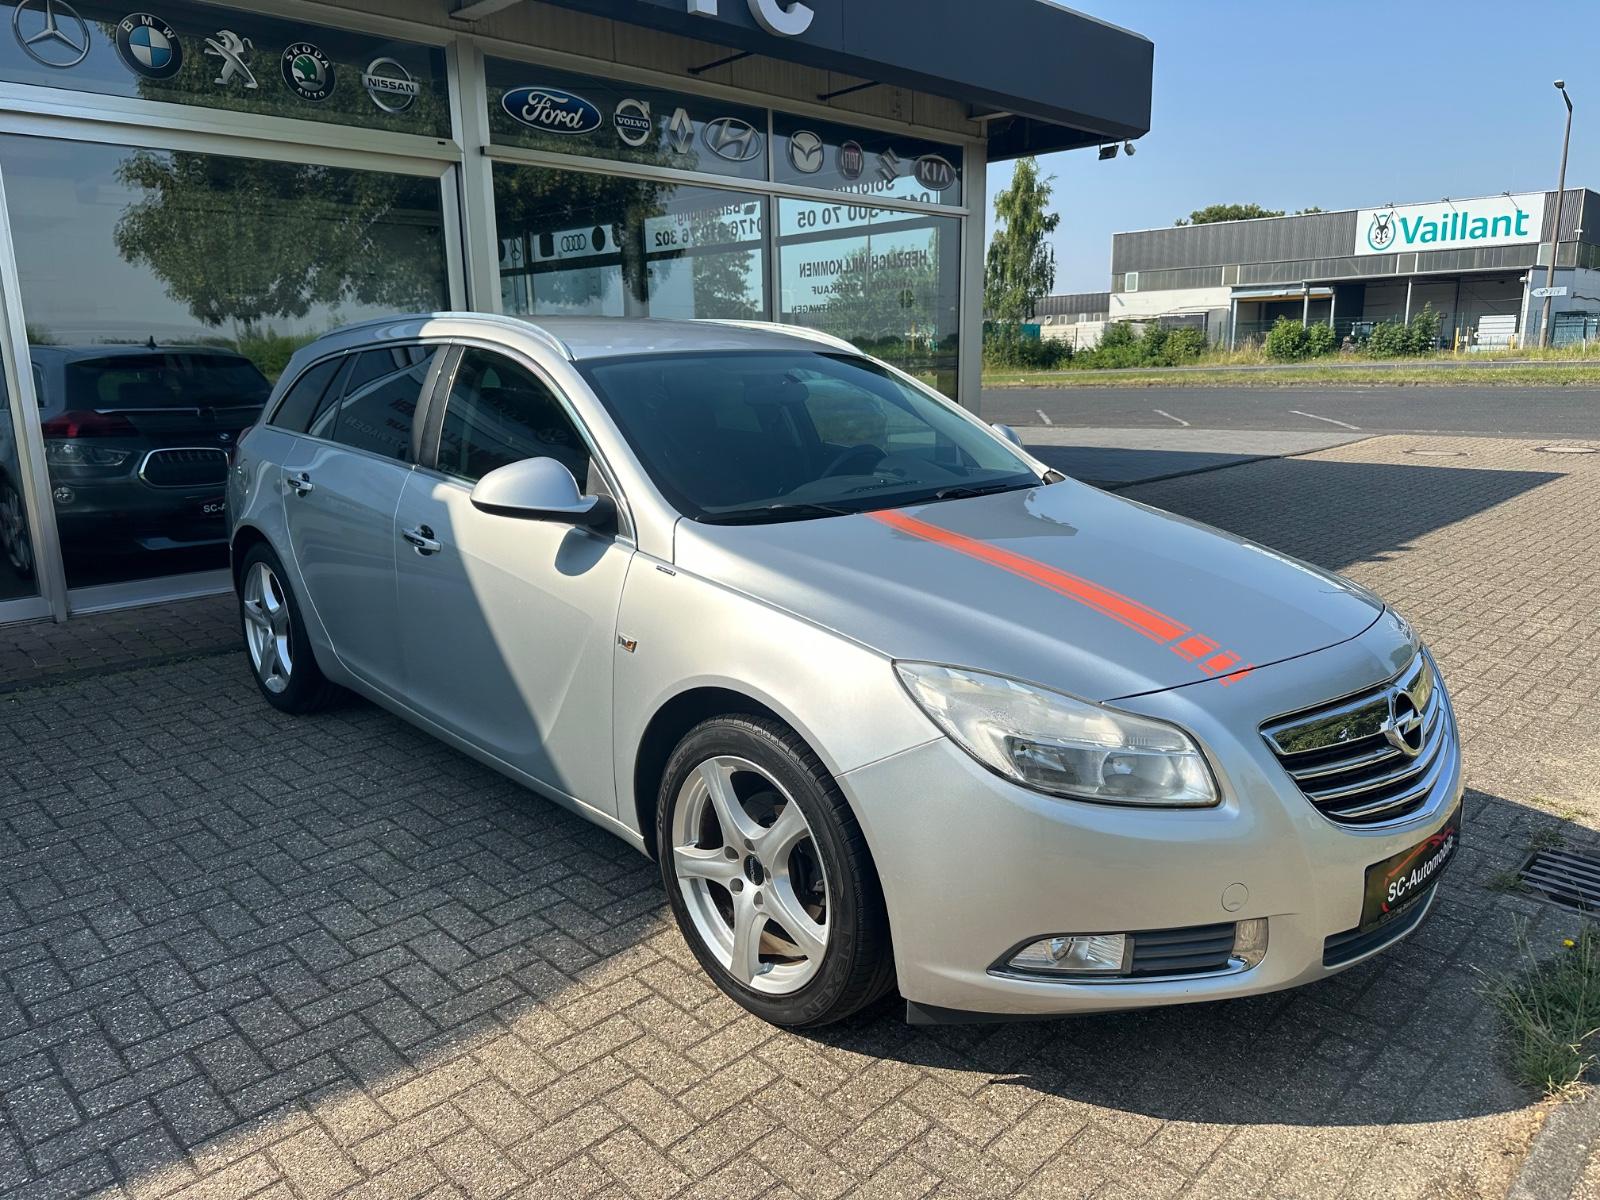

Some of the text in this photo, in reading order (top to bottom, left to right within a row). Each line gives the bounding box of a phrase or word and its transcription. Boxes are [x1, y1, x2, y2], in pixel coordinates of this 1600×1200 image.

[122, 15, 175, 39] BMW
[297, 87, 325, 99] AUTO
[368, 77, 415, 93] NISSAN
[522, 91, 584, 129] Ford
[616, 117, 649, 129] VOLVO
[844, 151, 859, 170] FIAT
[921, 161, 949, 182] KIA
[1400, 209, 1530, 245] Vaillant
